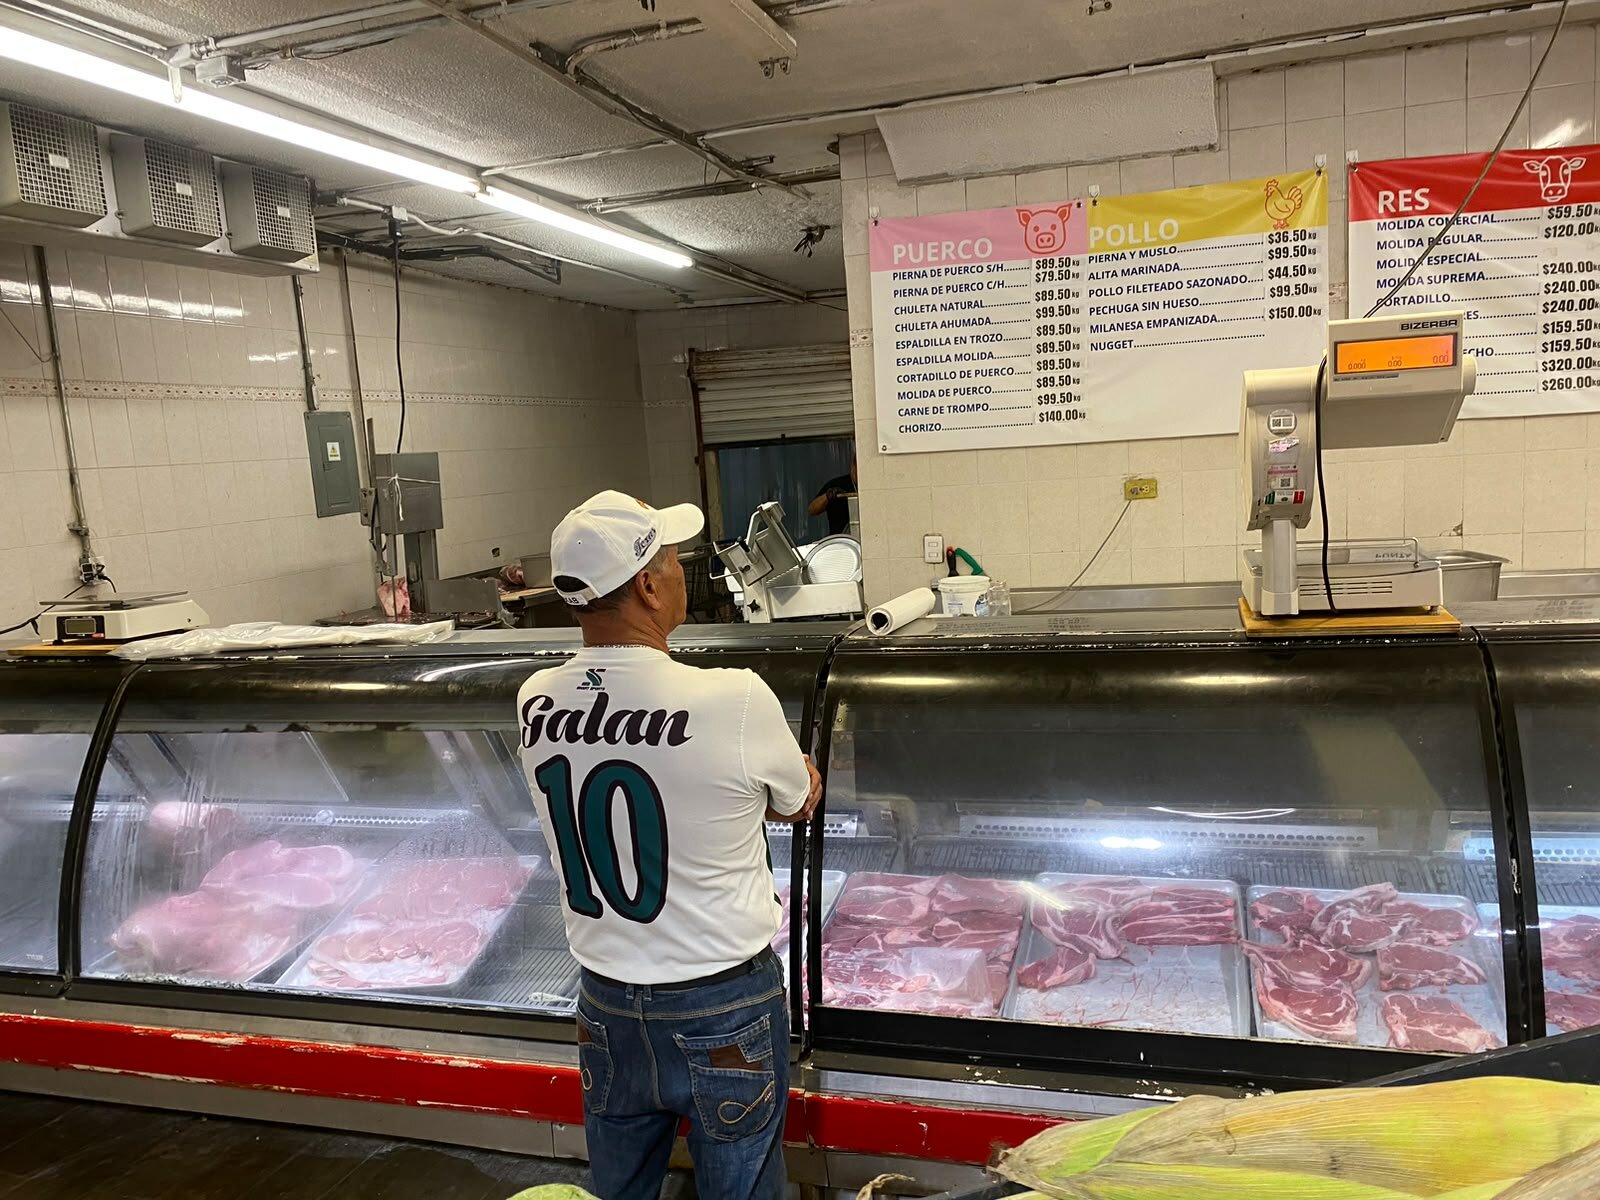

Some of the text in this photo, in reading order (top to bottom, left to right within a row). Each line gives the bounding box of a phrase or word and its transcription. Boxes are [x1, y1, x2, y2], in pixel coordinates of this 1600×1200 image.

[1378, 188, 1429, 214] RES
[1377, 218, 1425, 231] MOLIDA
[1428, 213, 1497, 226] COMERCIAL
[1547, 204, 1592, 220] $59.50
[1090, 218, 1179, 248] POLLO
[1377, 238, 1424, 250] MOLIDA
[1544, 222, 1594, 239] $120.00
[893, 238, 992, 265] PUERCO
[1089, 252, 1126, 264] PIERNA
[1129, 251, 1136, 259] Y
[1139, 246, 1177, 258] MUSLO
[1268, 229, 1306, 245] $36.50
[893, 270, 928, 280] PIERNA
[930, 268, 942, 277] DE
[945, 265, 984, 276] PUERCO
[986, 264, 1003, 273] S/H
[1036, 257, 1071, 270] $89.50
[1088, 270, 1118, 280] ALITA
[1121, 262, 1180, 277] MARINADA
[1268, 245, 1307, 260] $99.50
[1376, 252, 1482, 270] MOLID ESPECIAL
[1427, 271, 1485, 284] SUPREMA
[1543, 261, 1593, 275] $240.00
[894, 287, 929, 298] PIERNA
[931, 286, 943, 295] DE
[946, 282, 984, 293] PUERCO
[987, 280, 1004, 290] C/H
[1035, 269, 1070, 283] $79.50
[1089, 286, 1123, 298] POLLO
[1127, 281, 1183, 294] FILETEADO
[1187, 275, 1247, 289] SAZONADO
[1268, 264, 1306, 280] $44.50
[1376, 293, 1451, 308] CORTADILLO
[1544, 279, 1595, 295] $240.00
[894, 304, 937, 315] CHULETA
[940, 300, 985, 311] NATURAL
[1035, 288, 1070, 302] $89.50
[1089, 303, 1139, 316] PECHUGA
[1142, 301, 1159, 311] SIN
[1163, 298, 1199, 309] HUESO
[1270, 283, 1308, 298] $99.50
[1464, 310, 1479, 320] ES
[1542, 298, 1595, 314] $240.00
[895, 321, 938, 332] CHULETA
[940, 317, 991, 329] AHUMADA
[1036, 304, 1071, 319] $99.50
[1090, 321, 1144, 333] MILANESA
[1147, 314, 1217, 329] EMPANIZADA
[1269, 305, 1312, 320] $150.00
[1401, 319, 1458, 331] BIZERBA
[1542, 319, 1592, 335] $159.50
[896, 337, 951, 349] ESPALDILLA
[954, 336, 967, 345] EN
[970, 333, 1003, 344] TROZO
[1036, 323, 1071, 337] $89.50
[1091, 339, 1133, 351] NUGGET
[1542, 338, 1591, 353] $159.50
[896, 354, 952, 366] ESPALDILLA
[954, 351, 994, 362] MOLIDA
[1036, 340, 1071, 354] $89.50
[1542, 356, 1592, 372] $320.00
[897, 371, 957, 383] CORTADILLO
[960, 370, 972, 379] DE
[975, 367, 1014, 377] PUERCO
[1037, 358, 1071, 371] $89.50
[1542, 376, 1592, 391] $260.00
[898, 390, 936, 400] MOLIDA
[938, 389, 950, 397] DE
[953, 386, 992, 396] PUERCO
[1037, 375, 1071, 388] $89.50
[898, 407, 929, 417] CARNE
[932, 406, 944, 414] DE
[947, 403, 989, 413] TROMPO
[1038, 392, 1072, 406] $99.50
[899, 423, 941, 433] CHORIZO
[1039, 409, 1078, 423] $140.00
[522, 691, 693, 749] Galan
[535, 754, 669, 924] 10
